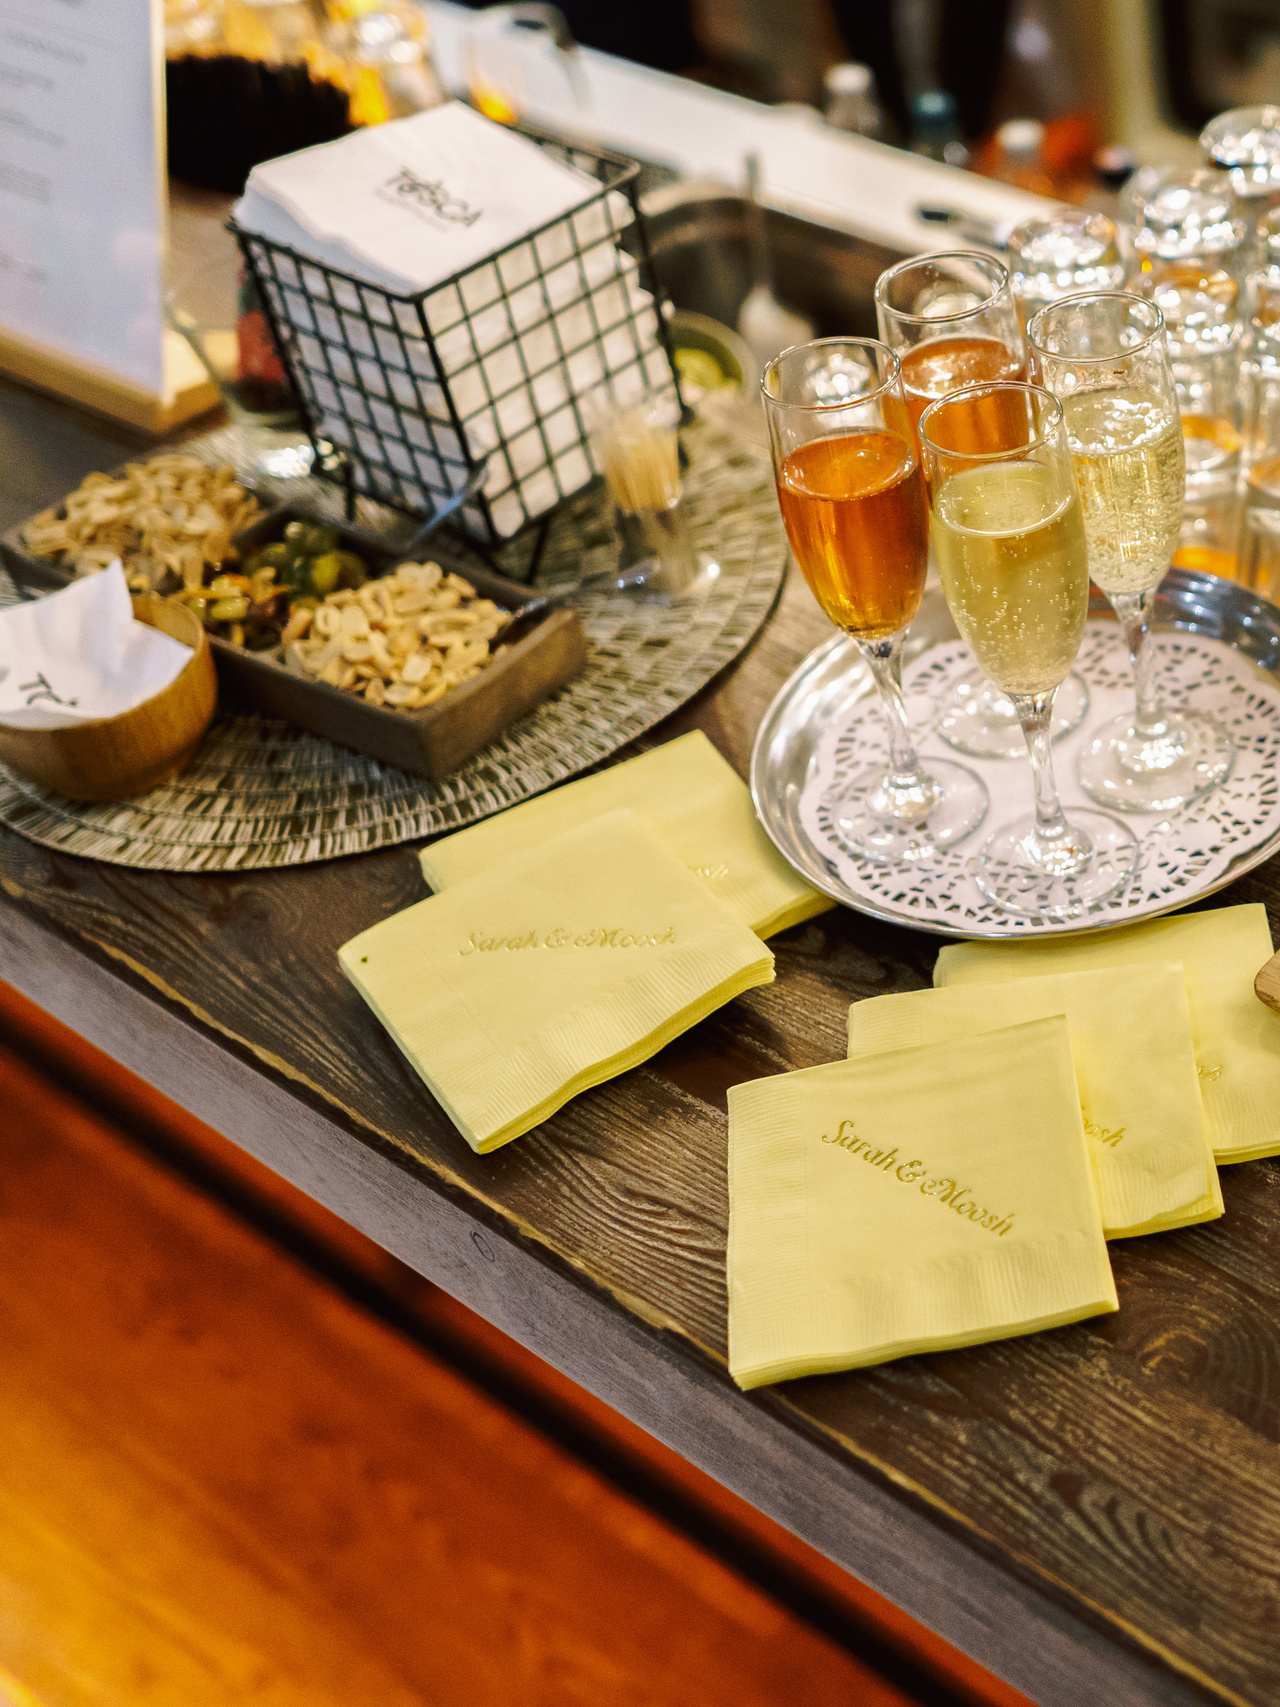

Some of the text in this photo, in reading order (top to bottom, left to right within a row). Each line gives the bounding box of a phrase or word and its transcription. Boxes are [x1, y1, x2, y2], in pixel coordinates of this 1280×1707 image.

[458, 926, 678, 956] Sarah & Moosh
[821, 1120, 1016, 1238] Sarah & Moosh
